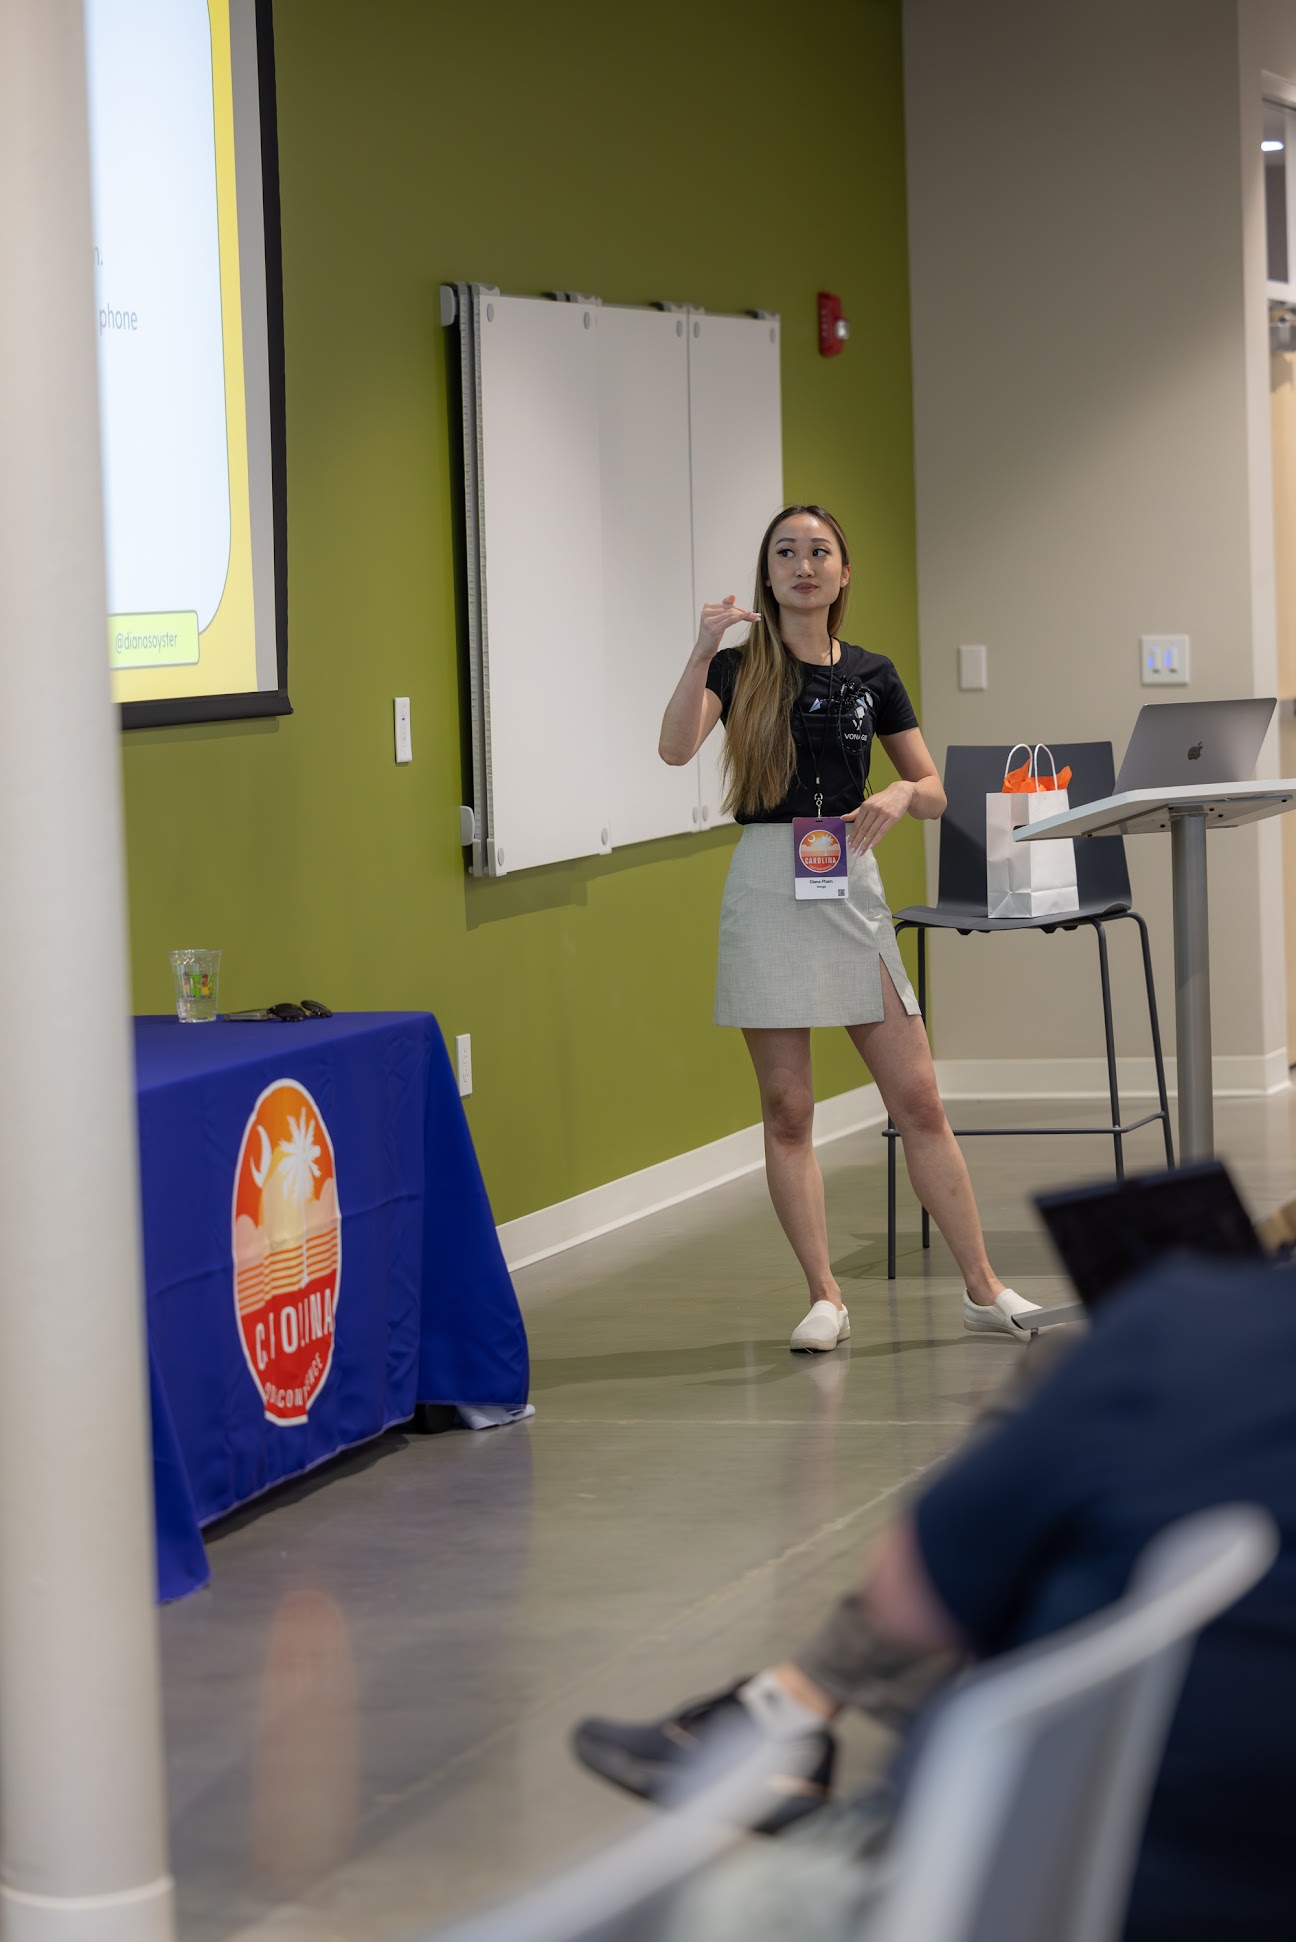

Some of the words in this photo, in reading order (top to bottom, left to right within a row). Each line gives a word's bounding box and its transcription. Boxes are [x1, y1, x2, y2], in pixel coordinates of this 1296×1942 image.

[99, 303, 138, 336] phone
[115, 632, 178, 654] @dianasoyster
[804, 857, 837, 865] CAROLINA
